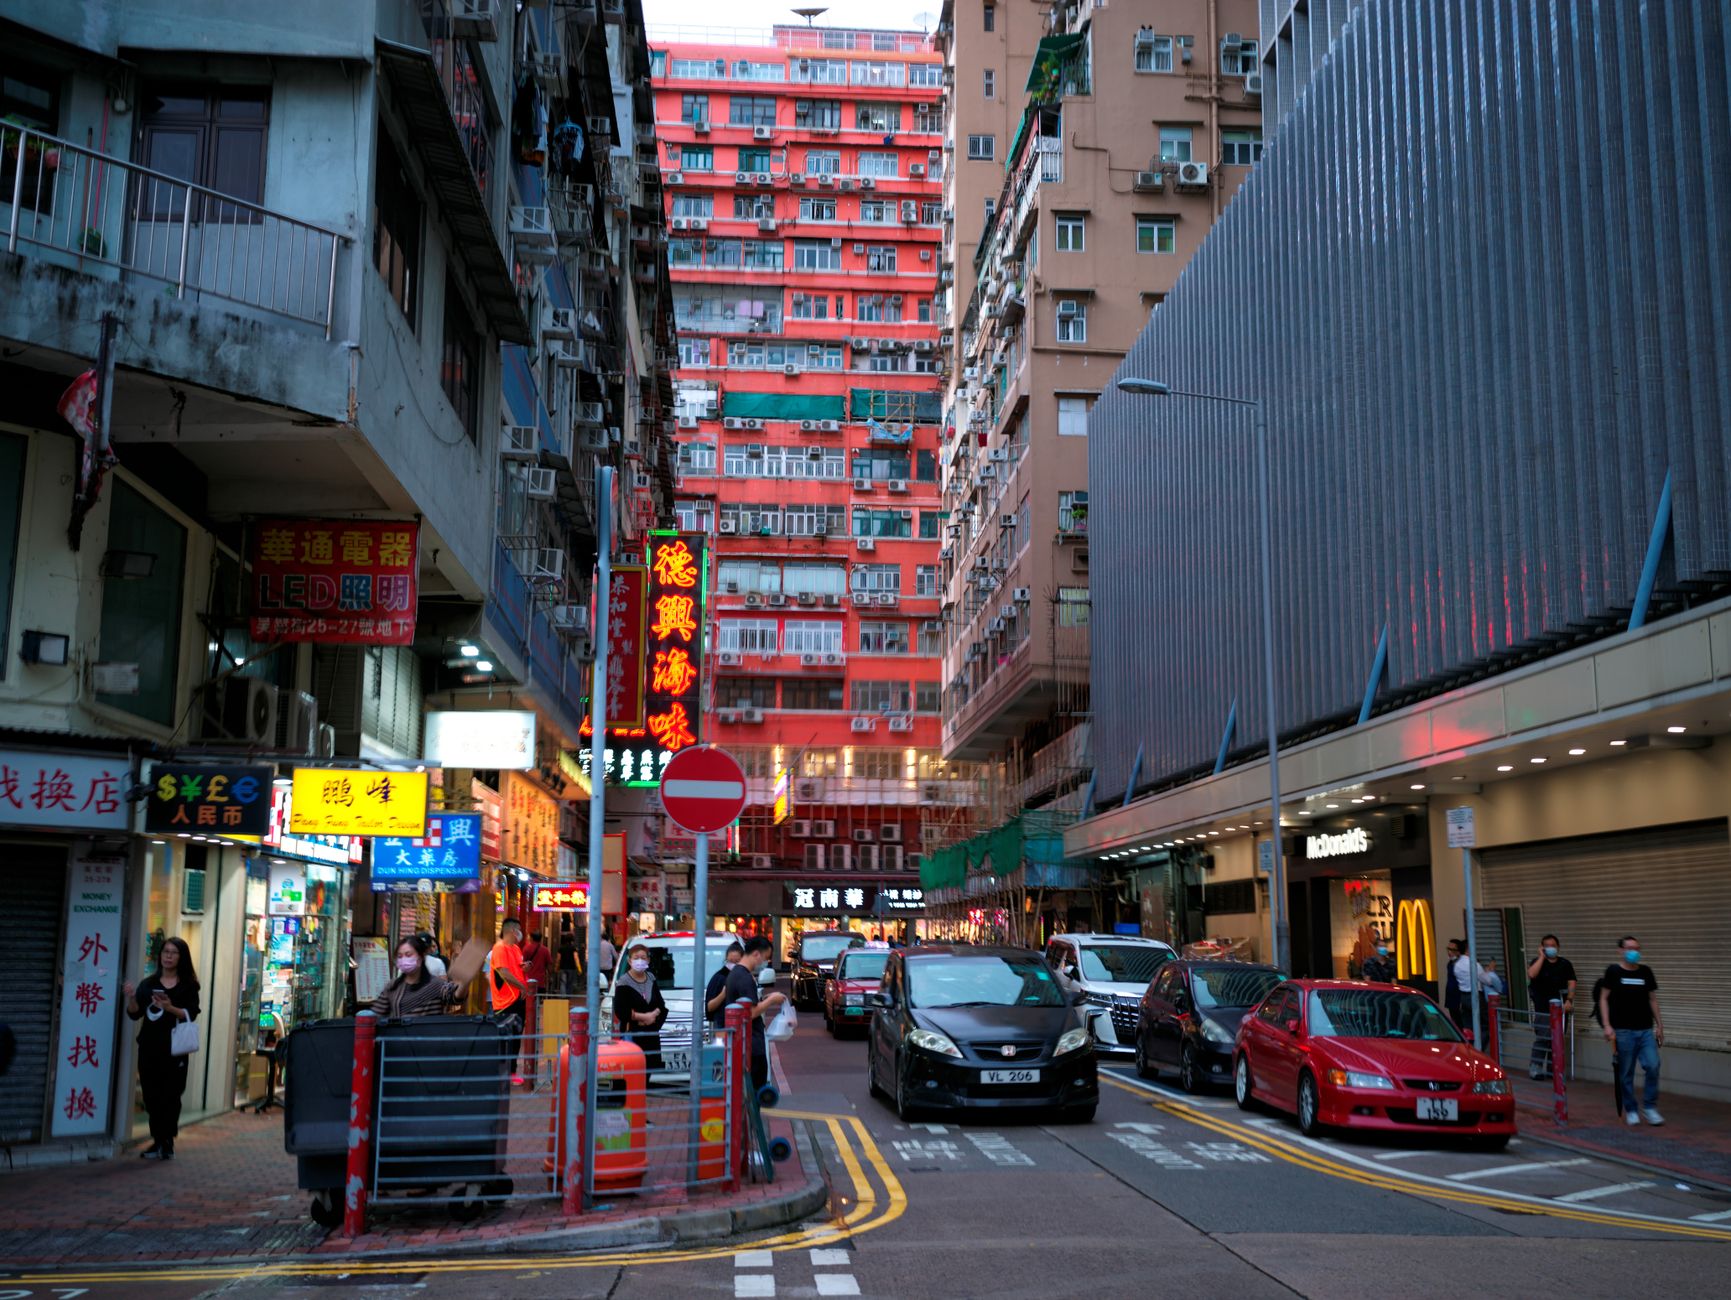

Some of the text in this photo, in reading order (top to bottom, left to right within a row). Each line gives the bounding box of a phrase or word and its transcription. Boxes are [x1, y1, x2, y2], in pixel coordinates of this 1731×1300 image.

[260, 528, 412, 566] 華通電器
[649, 541, 698, 750] 德興海味
[321, 776, 398, 808] 鵬峰
[171, 805, 243, 825] 人民币
[445, 818, 476, 846] 興
[1306, 827, 1368, 859] McDonald's
[395, 849, 460, 866] 大藥房
[377, 867, 474, 876] DUN HING DISPENSARY
[74, 905, 119, 913] EXCHANGE
[794, 888, 864, 909] 冠南華
[64, 933, 109, 1121] 外幣找換
[989, 1071, 1033, 1082] VL 206
